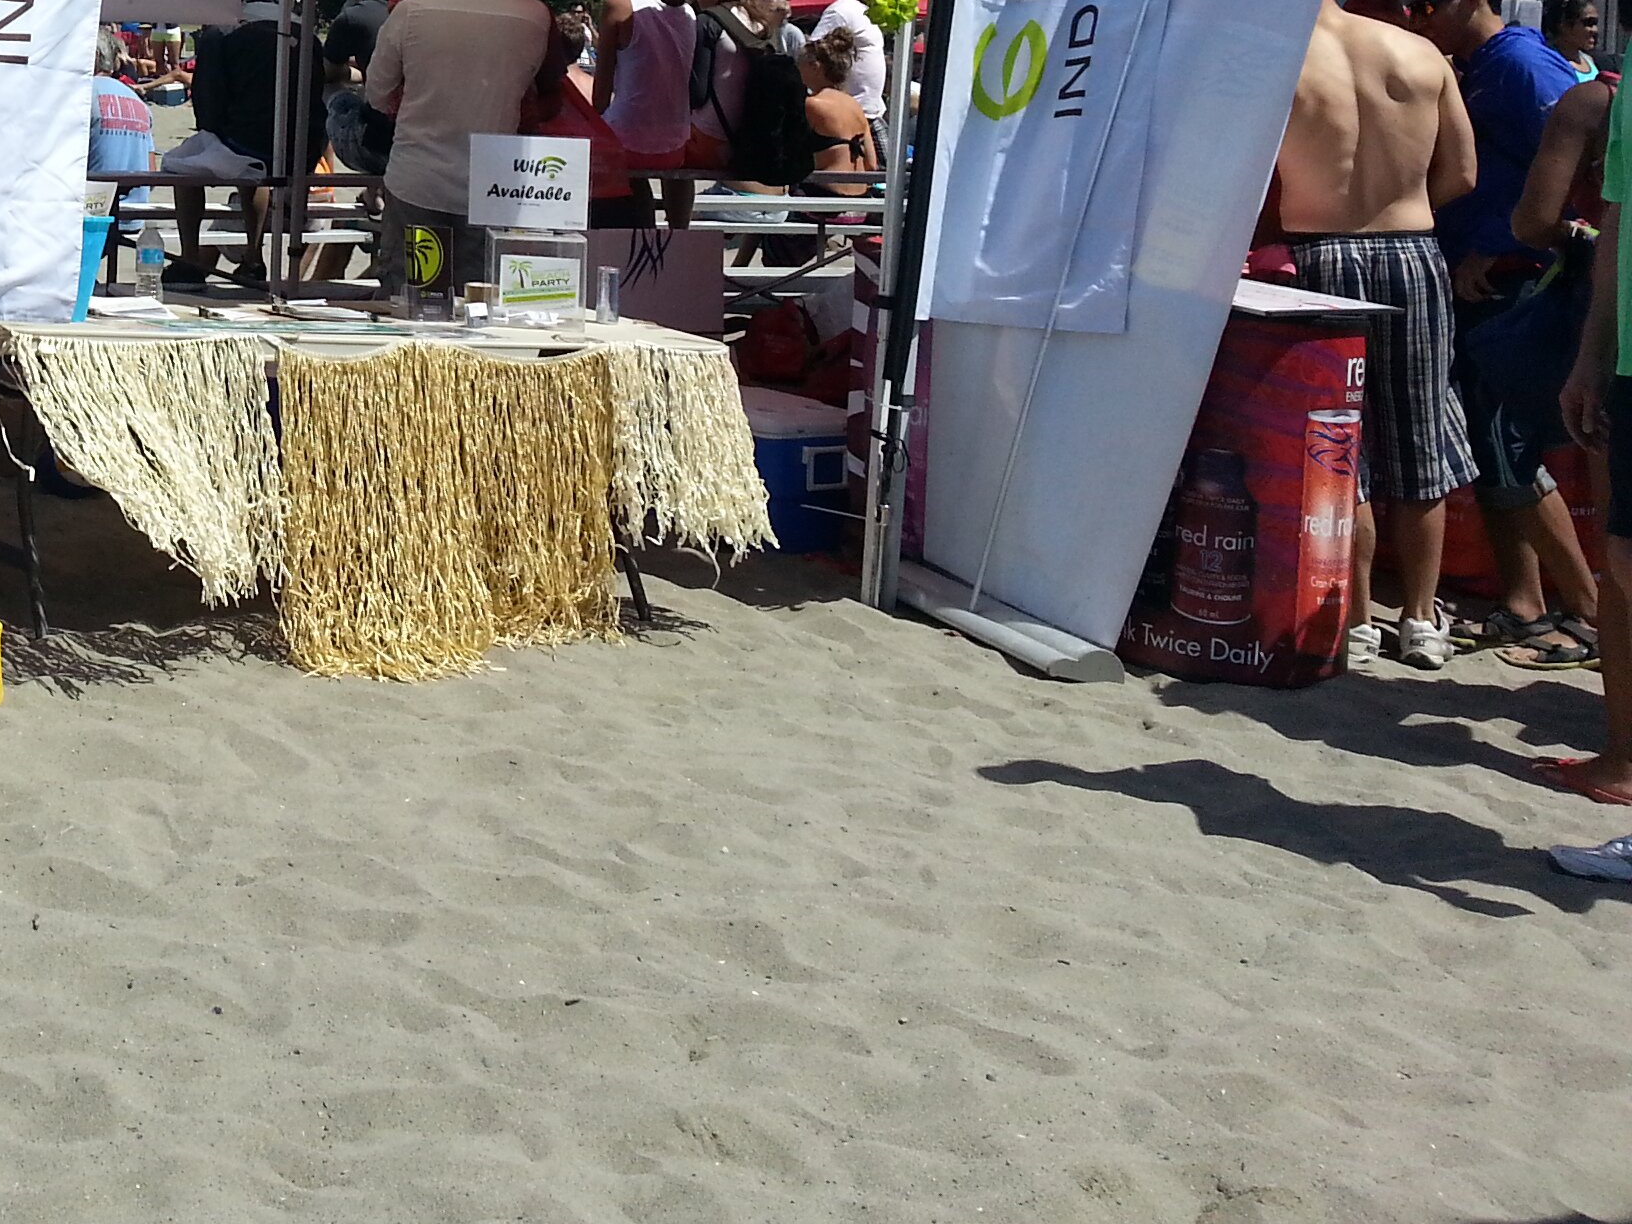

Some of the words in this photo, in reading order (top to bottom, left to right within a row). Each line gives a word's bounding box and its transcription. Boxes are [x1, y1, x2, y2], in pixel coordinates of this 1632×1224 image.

[513, 158, 547, 177] Wifi
[486, 183, 572, 202] Available
[531, 278, 570, 288] PARTY
[1176, 525, 1207, 547] red
[1215, 531, 1255, 551] rain
[1200, 549, 1224, 572] 12
[1142, 622, 1202, 657] Twice
[1210, 637, 1275, 674] Daily
